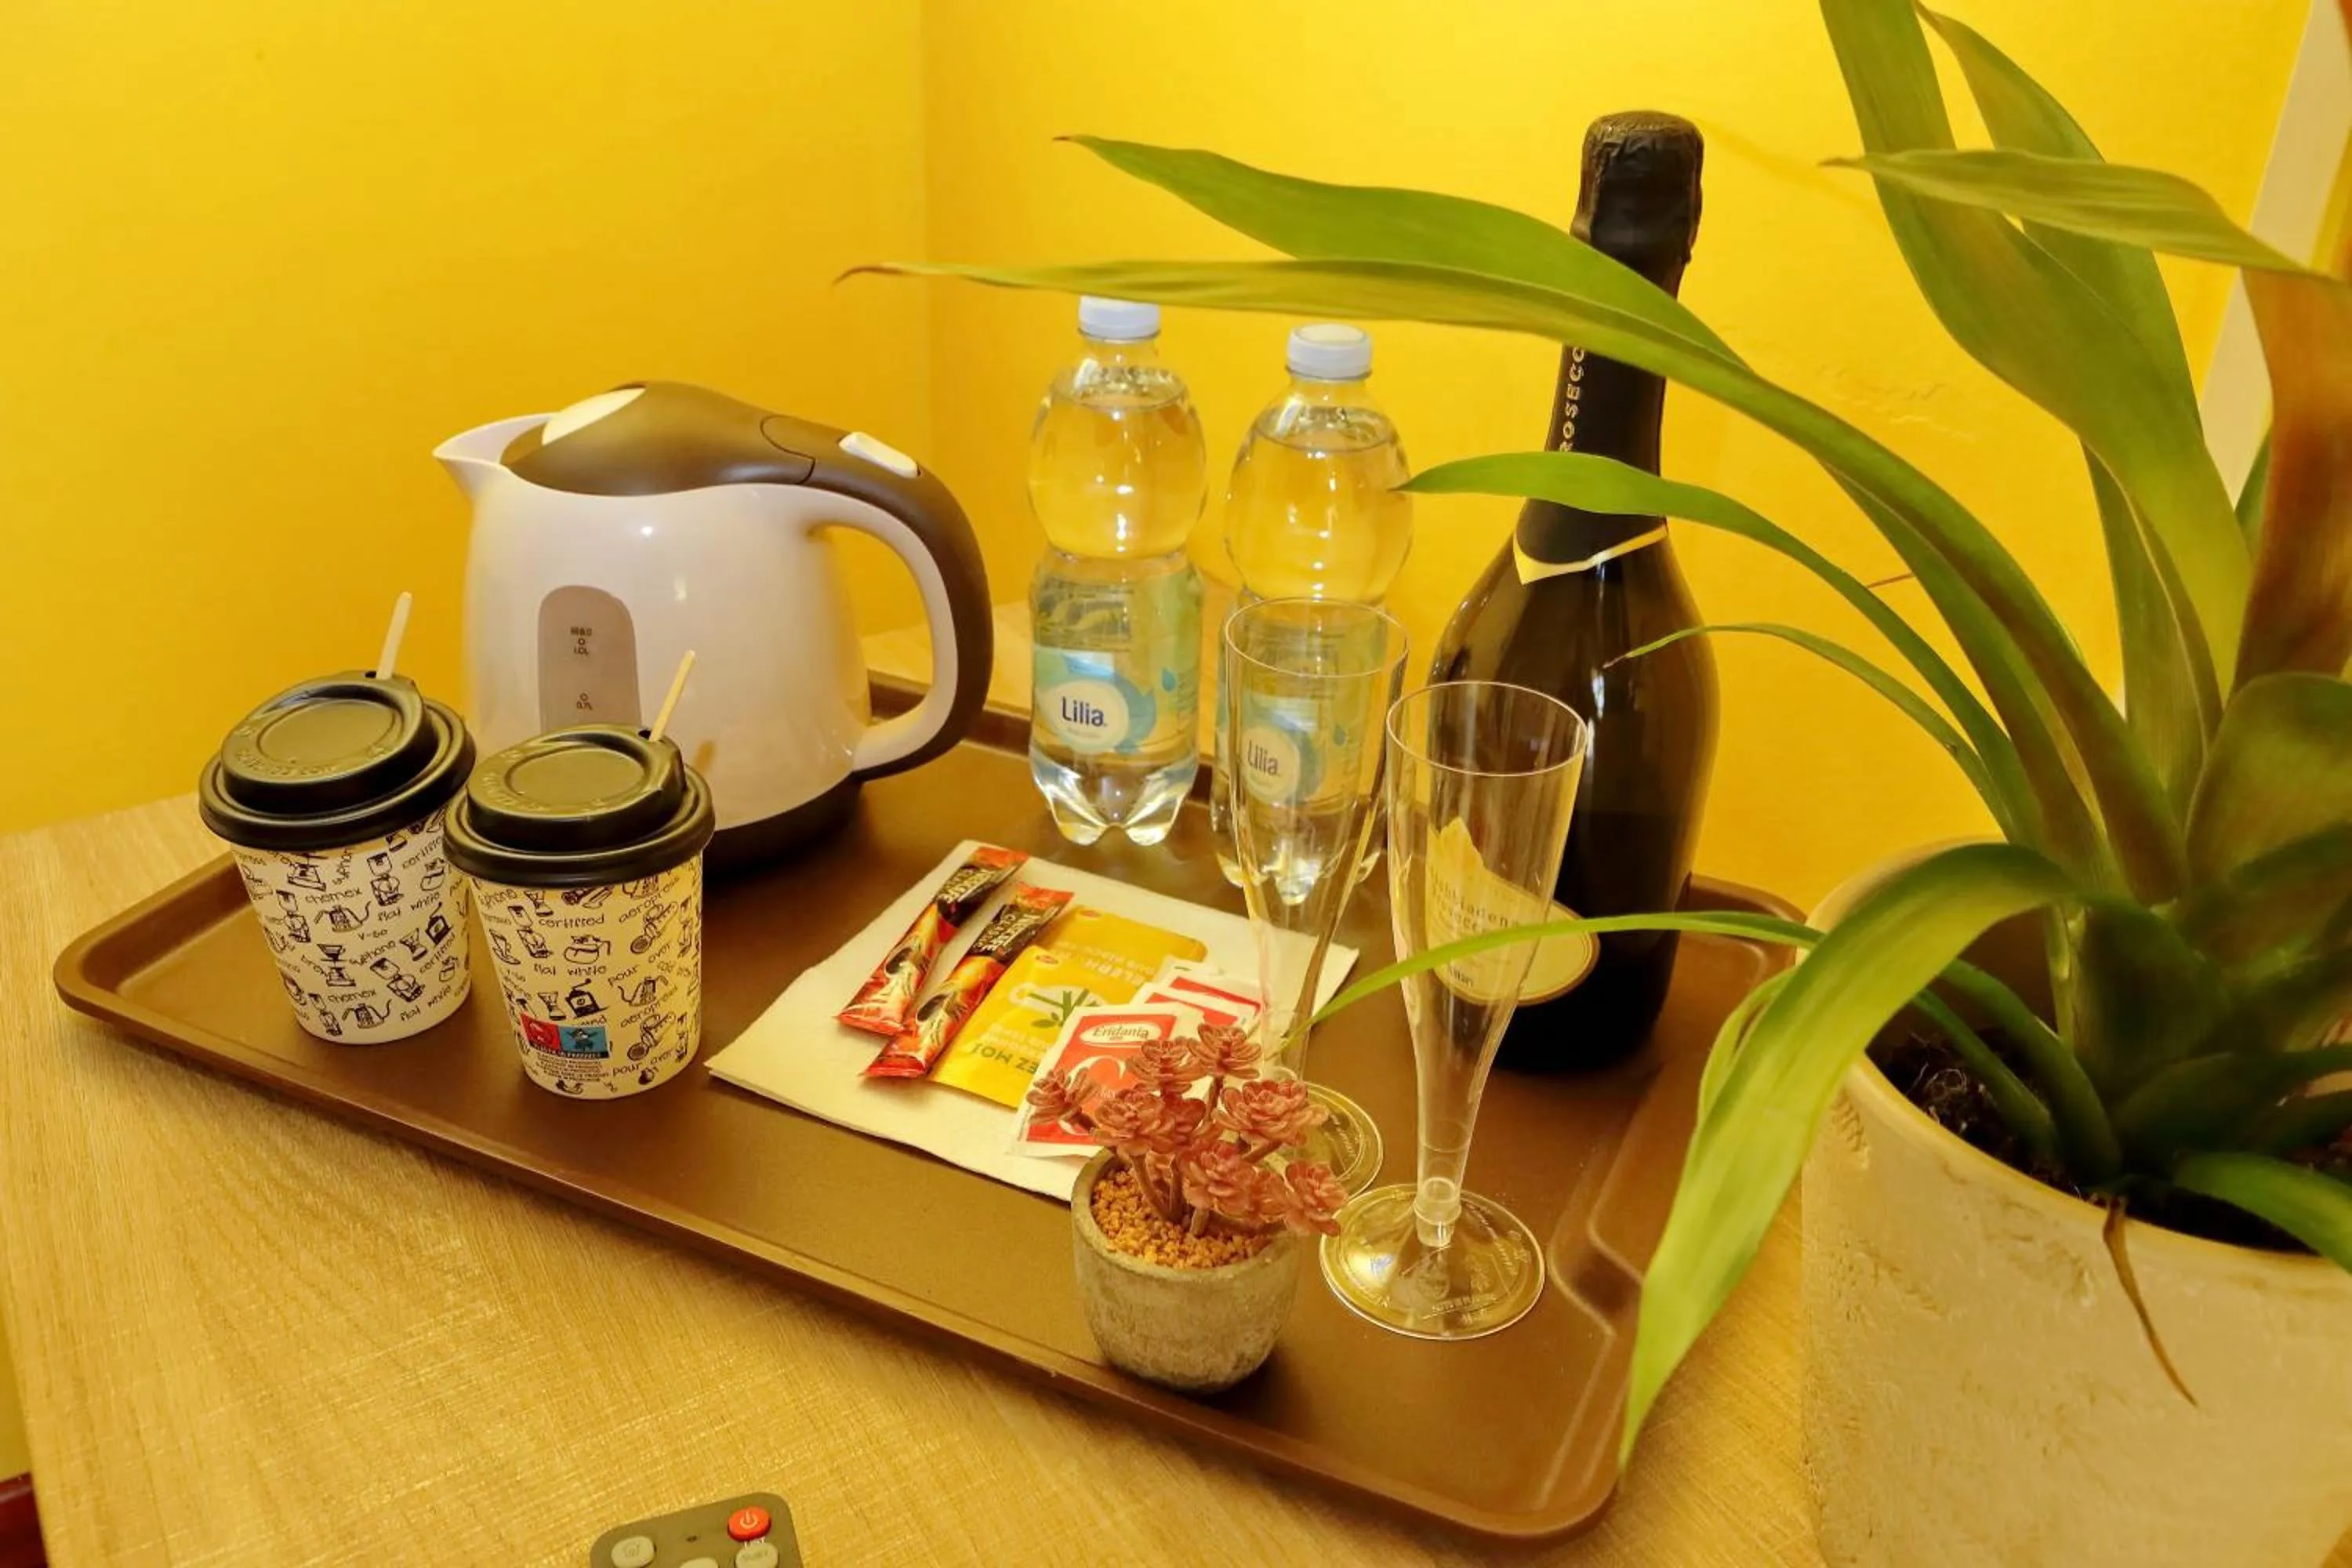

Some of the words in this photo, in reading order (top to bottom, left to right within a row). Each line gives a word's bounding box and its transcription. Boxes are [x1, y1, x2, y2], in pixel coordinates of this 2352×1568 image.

[305, 887, 364, 903] chemex
[539, 913, 605, 929] certified
[567, 964, 607, 977] white
[608, 964, 641, 988] pour
